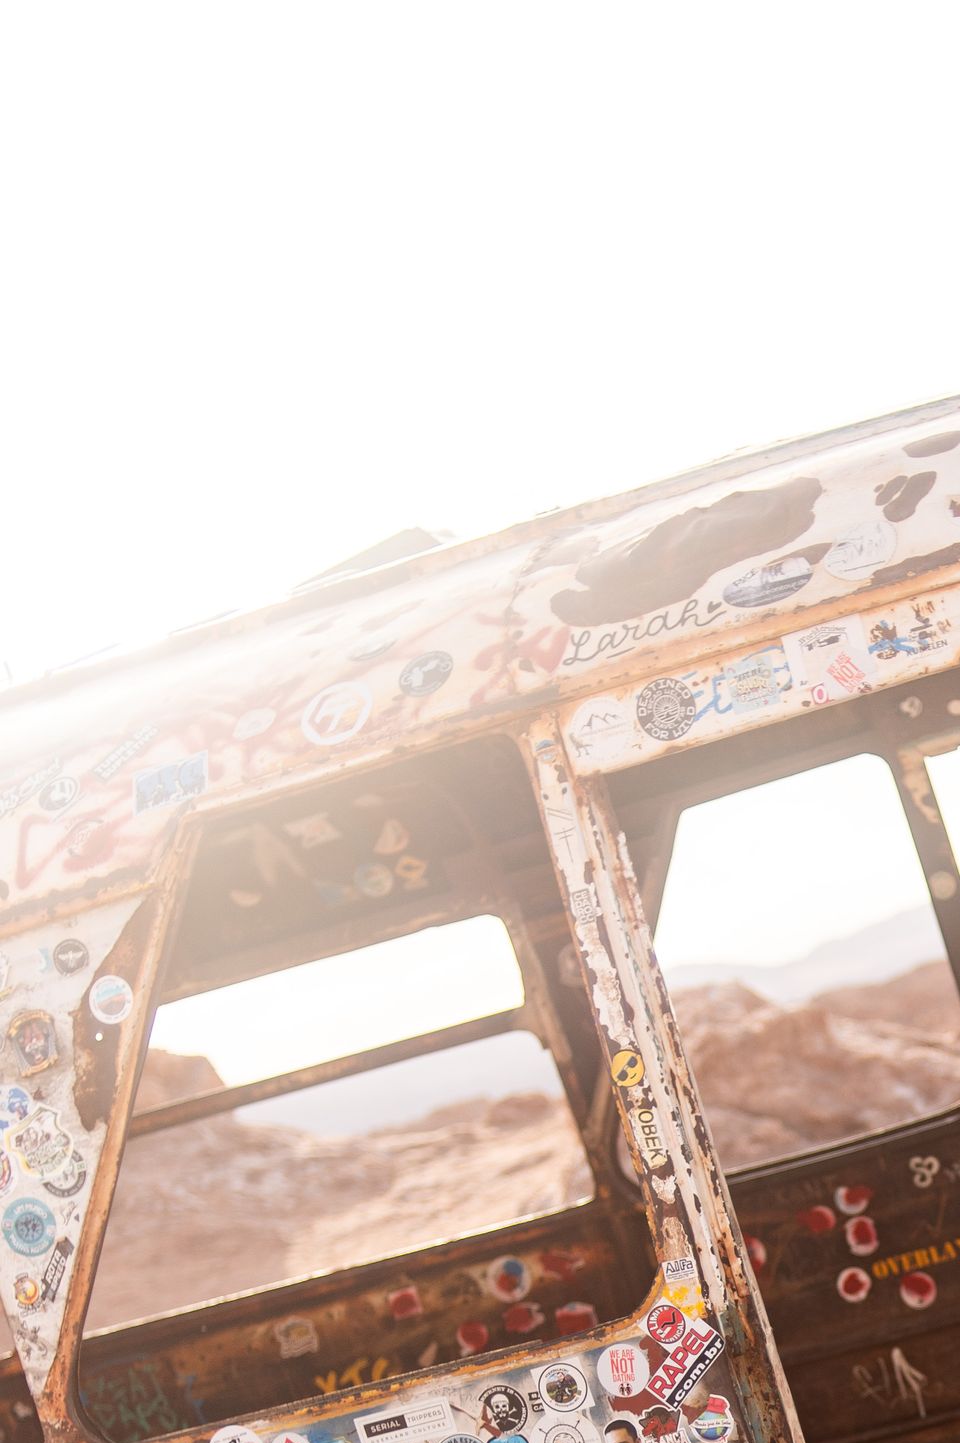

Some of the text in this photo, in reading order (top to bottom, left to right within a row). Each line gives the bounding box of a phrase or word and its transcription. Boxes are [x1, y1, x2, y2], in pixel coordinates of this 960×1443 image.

[638, 678, 692, 718] DESTINED
[644, 706, 696, 739] FOR WILD
[647, 1306, 671, 1331] LIMITE
[610, 1349, 635, 1360] WE ARE
[610, 1358, 635, 1375] NOT
[650, 1329, 714, 1399] RAPEL
[612, 1373, 636, 1383] DATING
[672, 1337, 724, 1408] .com.br
[370, 1409, 443, 1433] SERIAL TRIPPERS
